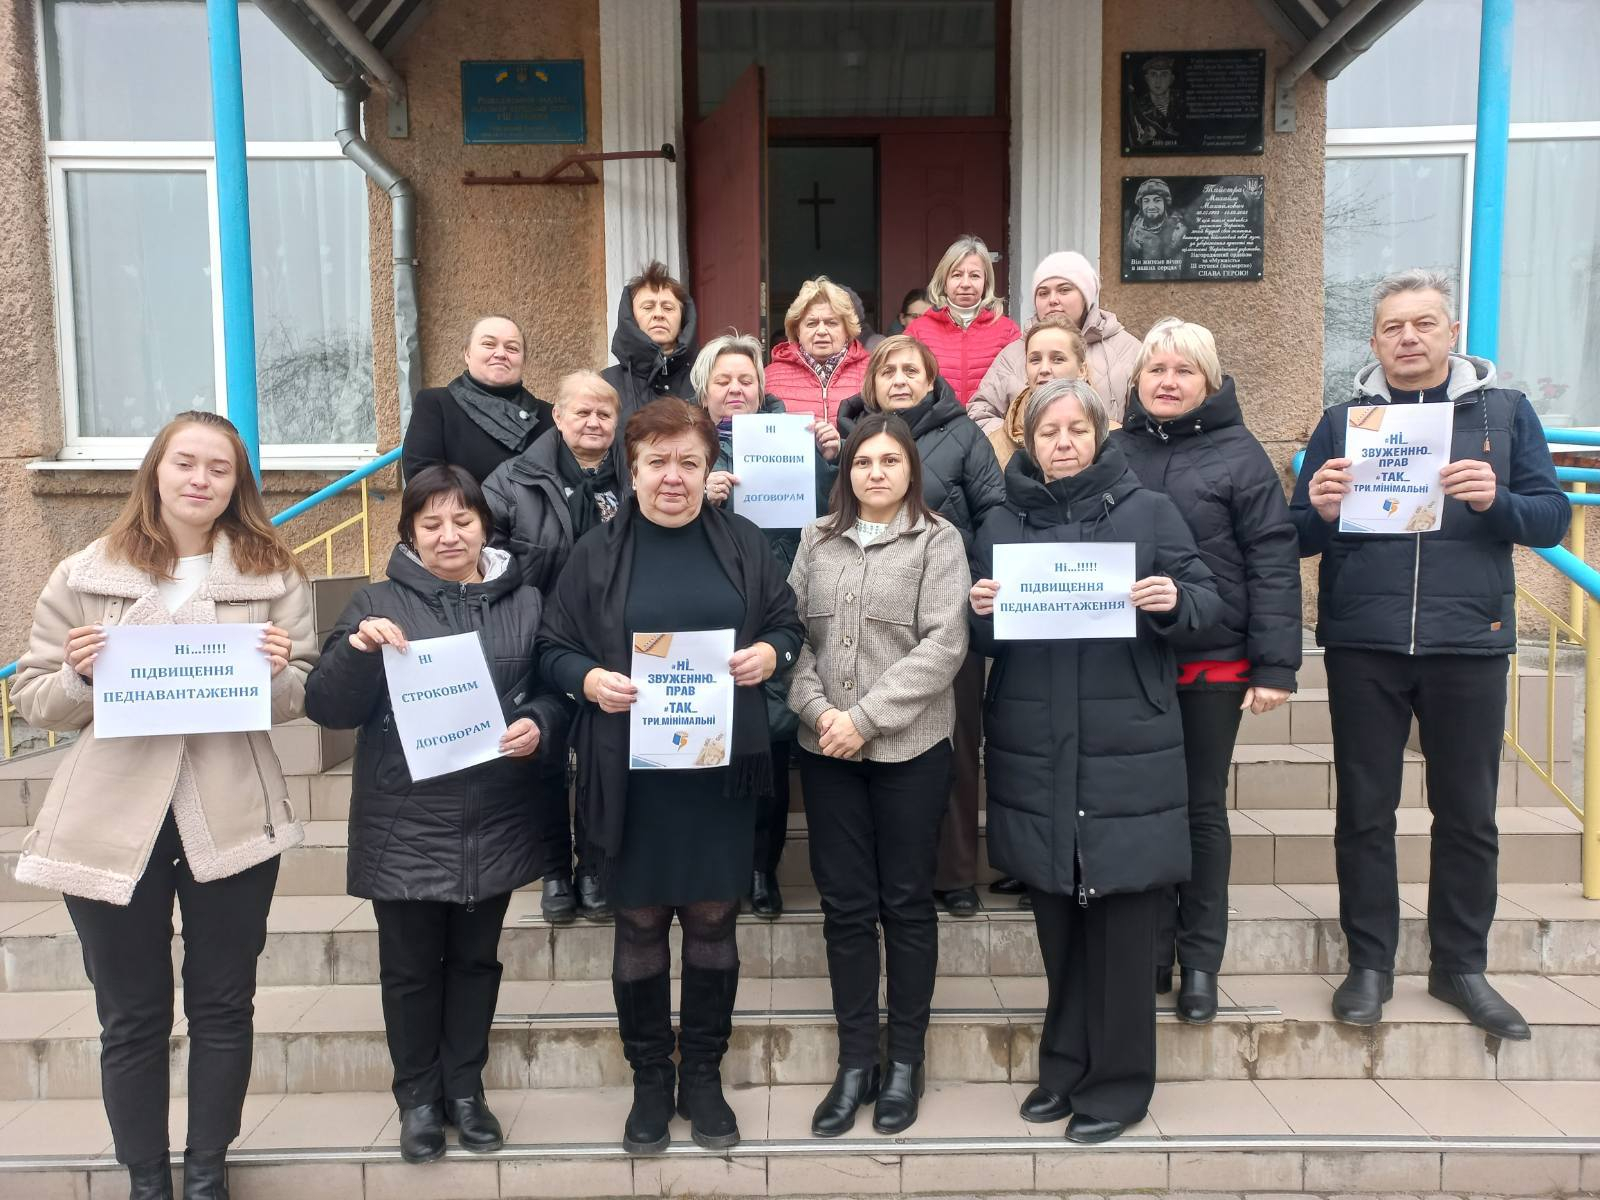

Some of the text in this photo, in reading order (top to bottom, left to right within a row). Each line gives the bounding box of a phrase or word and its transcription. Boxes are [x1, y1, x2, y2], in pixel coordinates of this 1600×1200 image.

[765, 425, 776, 433] НІ
[743, 455, 804, 464] СТРОКОВИМ
[1379, 458, 1409, 467] ПРАВ
[743, 493, 805, 502] ДОГОВОРАМ
[1020, 582, 1104, 594] ПІДВИЩЕННЯ
[1000, 601, 1125, 613] ПЕДНАВАНТАЖЕННЯ
[418, 653, 432, 664] НІ
[130, 665, 234, 680] ПІДВИЩЕННЯ
[103, 686, 259, 704] ПЕДНАВАНТАЖЕННЯ
[401, 681, 479, 703] СТРОКОВИМ
[666, 686, 696, 696] ПРАВ
[416, 720, 492, 750] ДОГОВОРАМ
